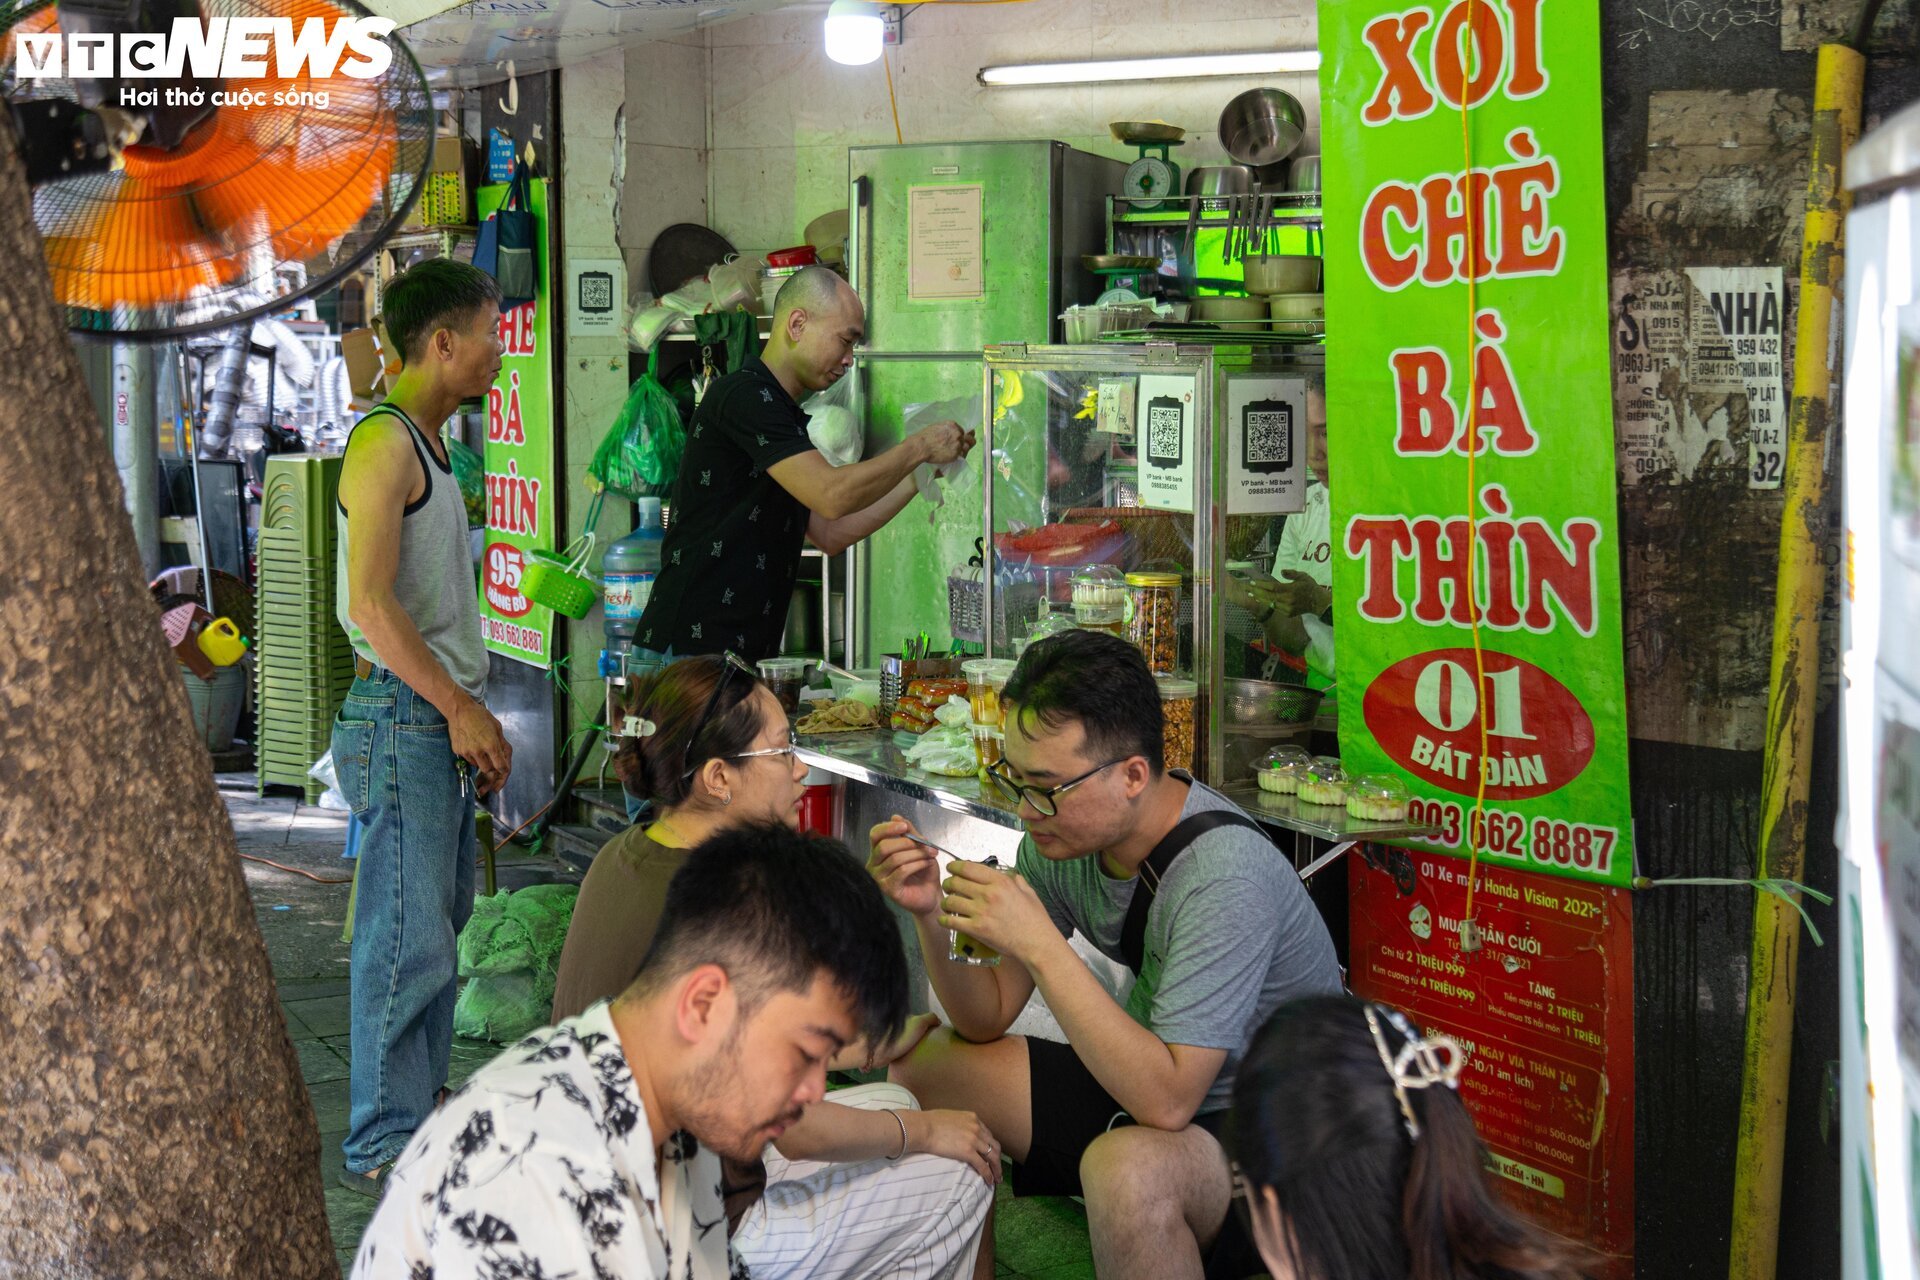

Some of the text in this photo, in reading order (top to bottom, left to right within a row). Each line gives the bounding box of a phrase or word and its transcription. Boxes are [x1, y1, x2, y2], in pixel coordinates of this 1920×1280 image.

[1360, 128, 1565, 292] CHÈ
[1710, 282, 1779, 335] NHÀ
[1737, 338, 1756, 355] 959
[1760, 338, 1777, 355] 432
[1390, 309, 1537, 456] BÀ
[487, 371, 525, 446] BÀ
[1762, 429, 1778, 444] A-Z
[1248, 487, 1286, 495] 0988385455
[490, 548, 522, 589] 95
[1346, 484, 1601, 637] THÌN
[487, 585, 513, 612] HÀNG
[489, 618, 505, 643] 093
[505, 622, 521, 649] 662
[521, 627, 544, 656] 8887
[1414, 659, 1537, 741] 01
[1410, 735, 1548, 788] BÁT ĐÀN
[1468, 806, 1525, 858] 662
[1531, 818, 1616, 872] 8887
[1421, 861, 1435, 878] 01
[1438, 865, 1454, 884] Xe
[1484, 878, 1519, 900] Honda
[1523, 886, 1559, 911] Vision
[1563, 896, 1594, 919] 2021
[1406, 950, 1414, 963] 2
[1416, 953, 1445, 974] TRIỆU
[1445, 961, 1466, 978] 999
[1508, 934, 1542, 957] CƯỚI
[1372, 963, 1387, 976] Kim
[1420, 976, 1428, 988] 4
[1429, 978, 1457, 999] TRIỆU
[1456, 988, 1476, 1003] 999
[1524, 1015, 1533, 1026] TS
[1565, 1025, 1571, 1037] 1
[1573, 1027, 1601, 1047] TRIỆU
[1547, 1003, 1555, 1015] 2
[1556, 1005, 1585, 1025] TRIỆU
[1534, 1142, 1574, 1165] 100.000đ
[1549, 1127, 1591, 1151] 500.000đ
[1503, 1164, 1524, 1181] KIẾM
[1531, 1177, 1546, 1191] HN
